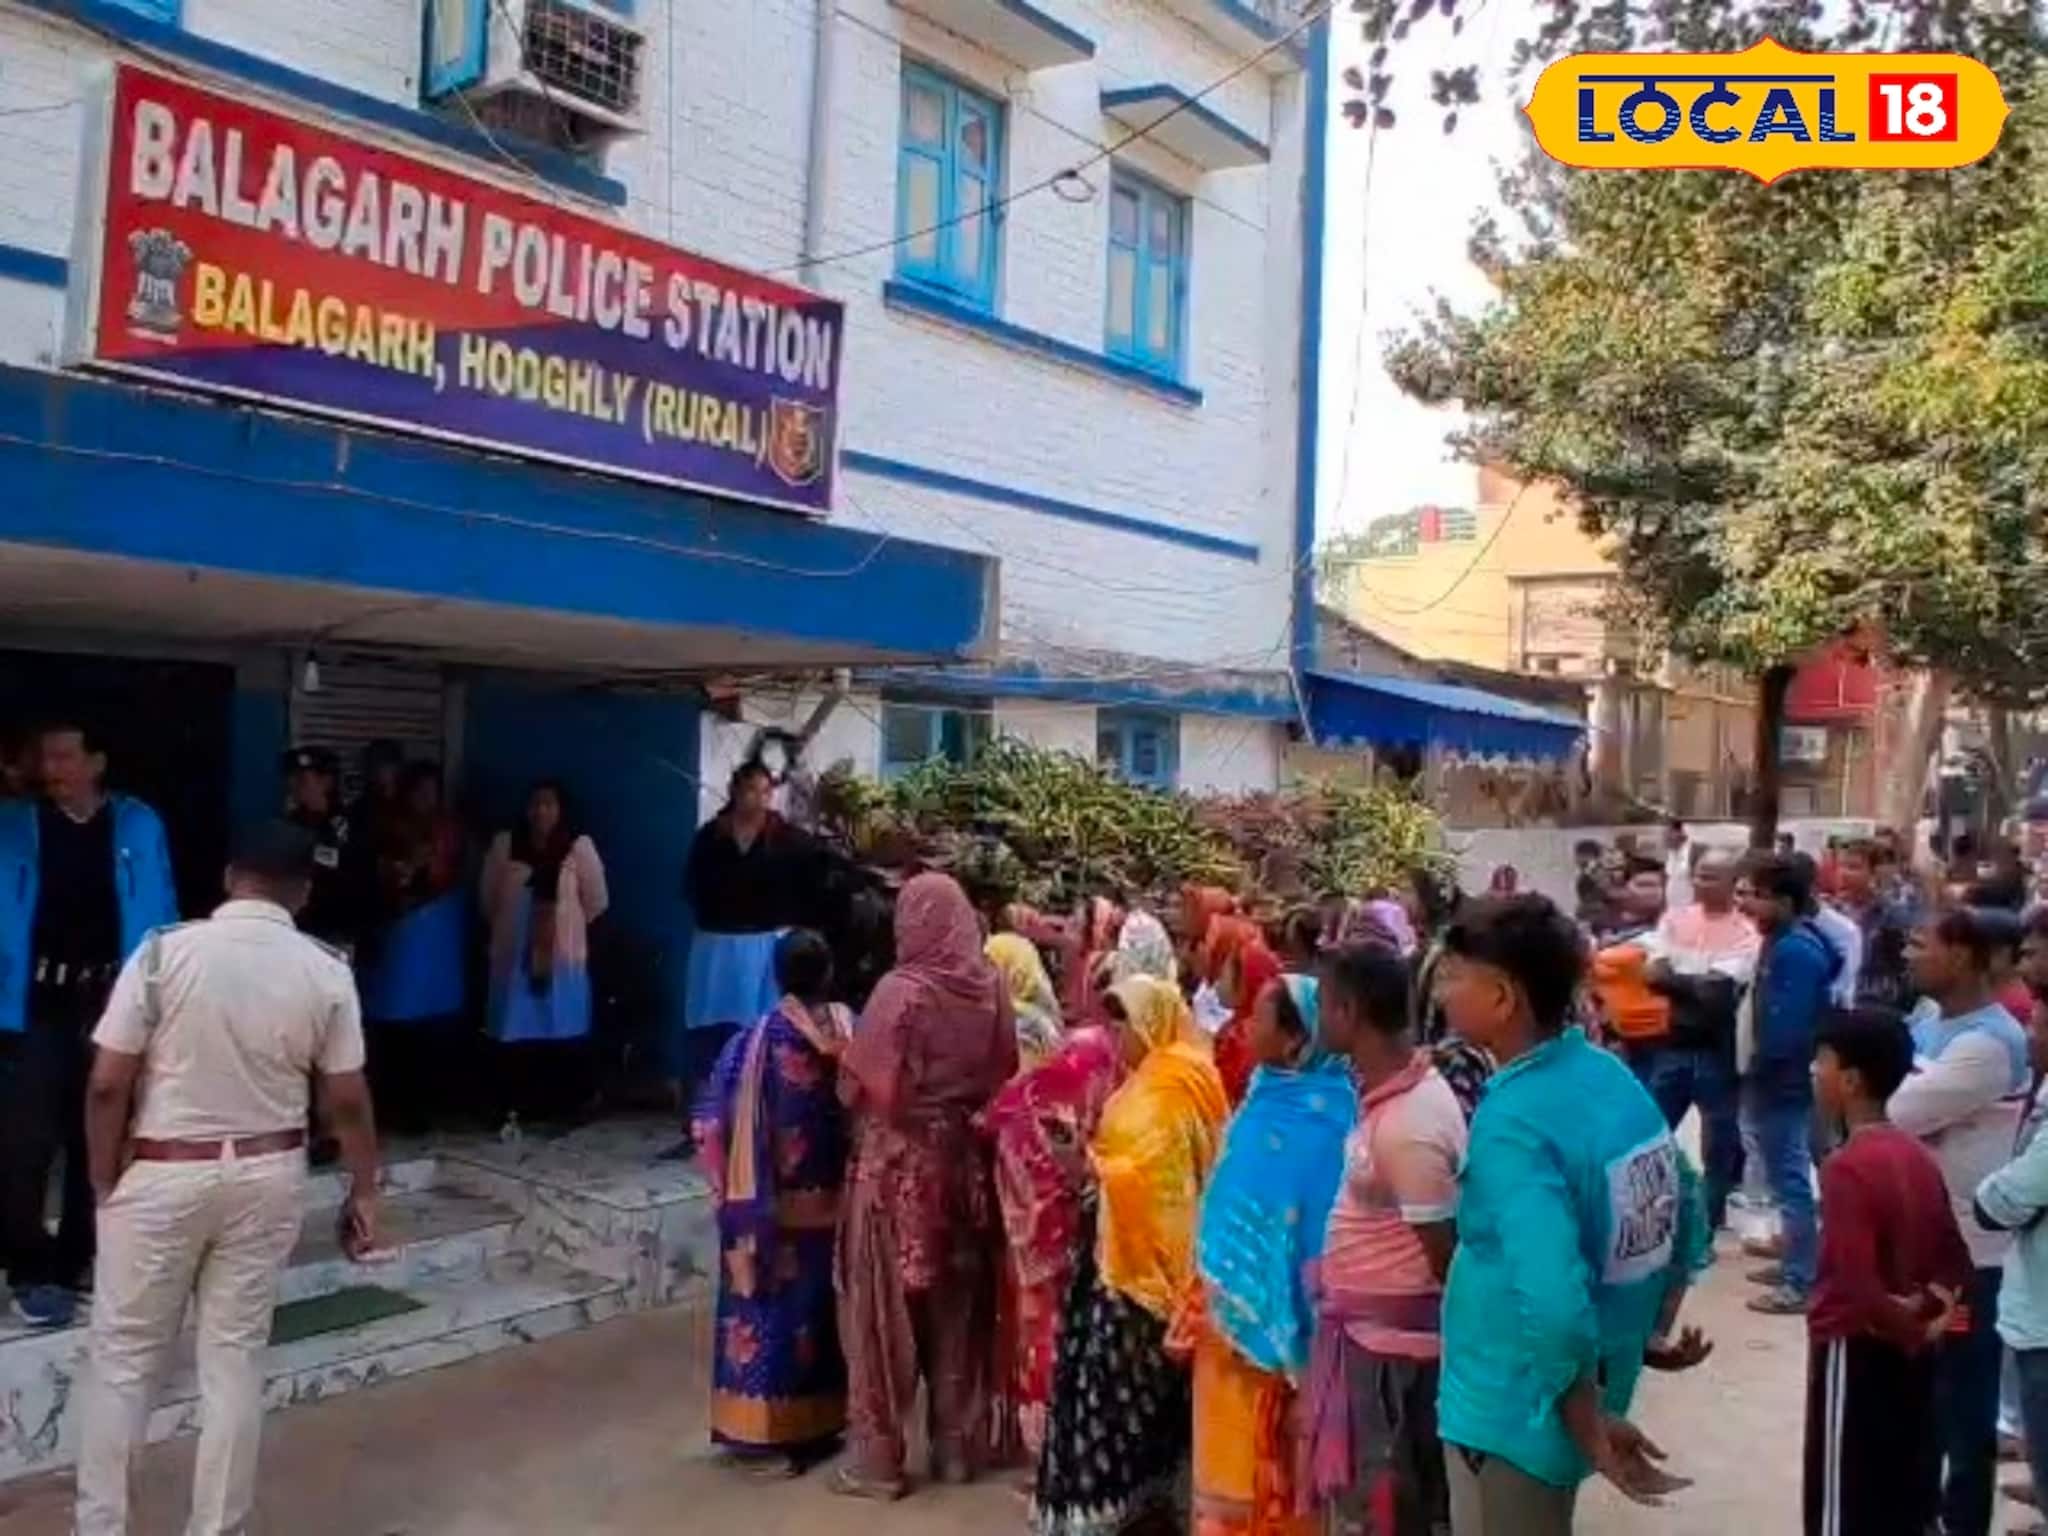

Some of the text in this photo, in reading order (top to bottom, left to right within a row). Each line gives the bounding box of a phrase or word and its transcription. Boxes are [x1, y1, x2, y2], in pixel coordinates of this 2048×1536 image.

[131, 98, 832, 390] BALAGARH POLICE STATION
[192, 262, 445, 391] BALAGARH,
[643, 381, 768, 470] (RURAL)
